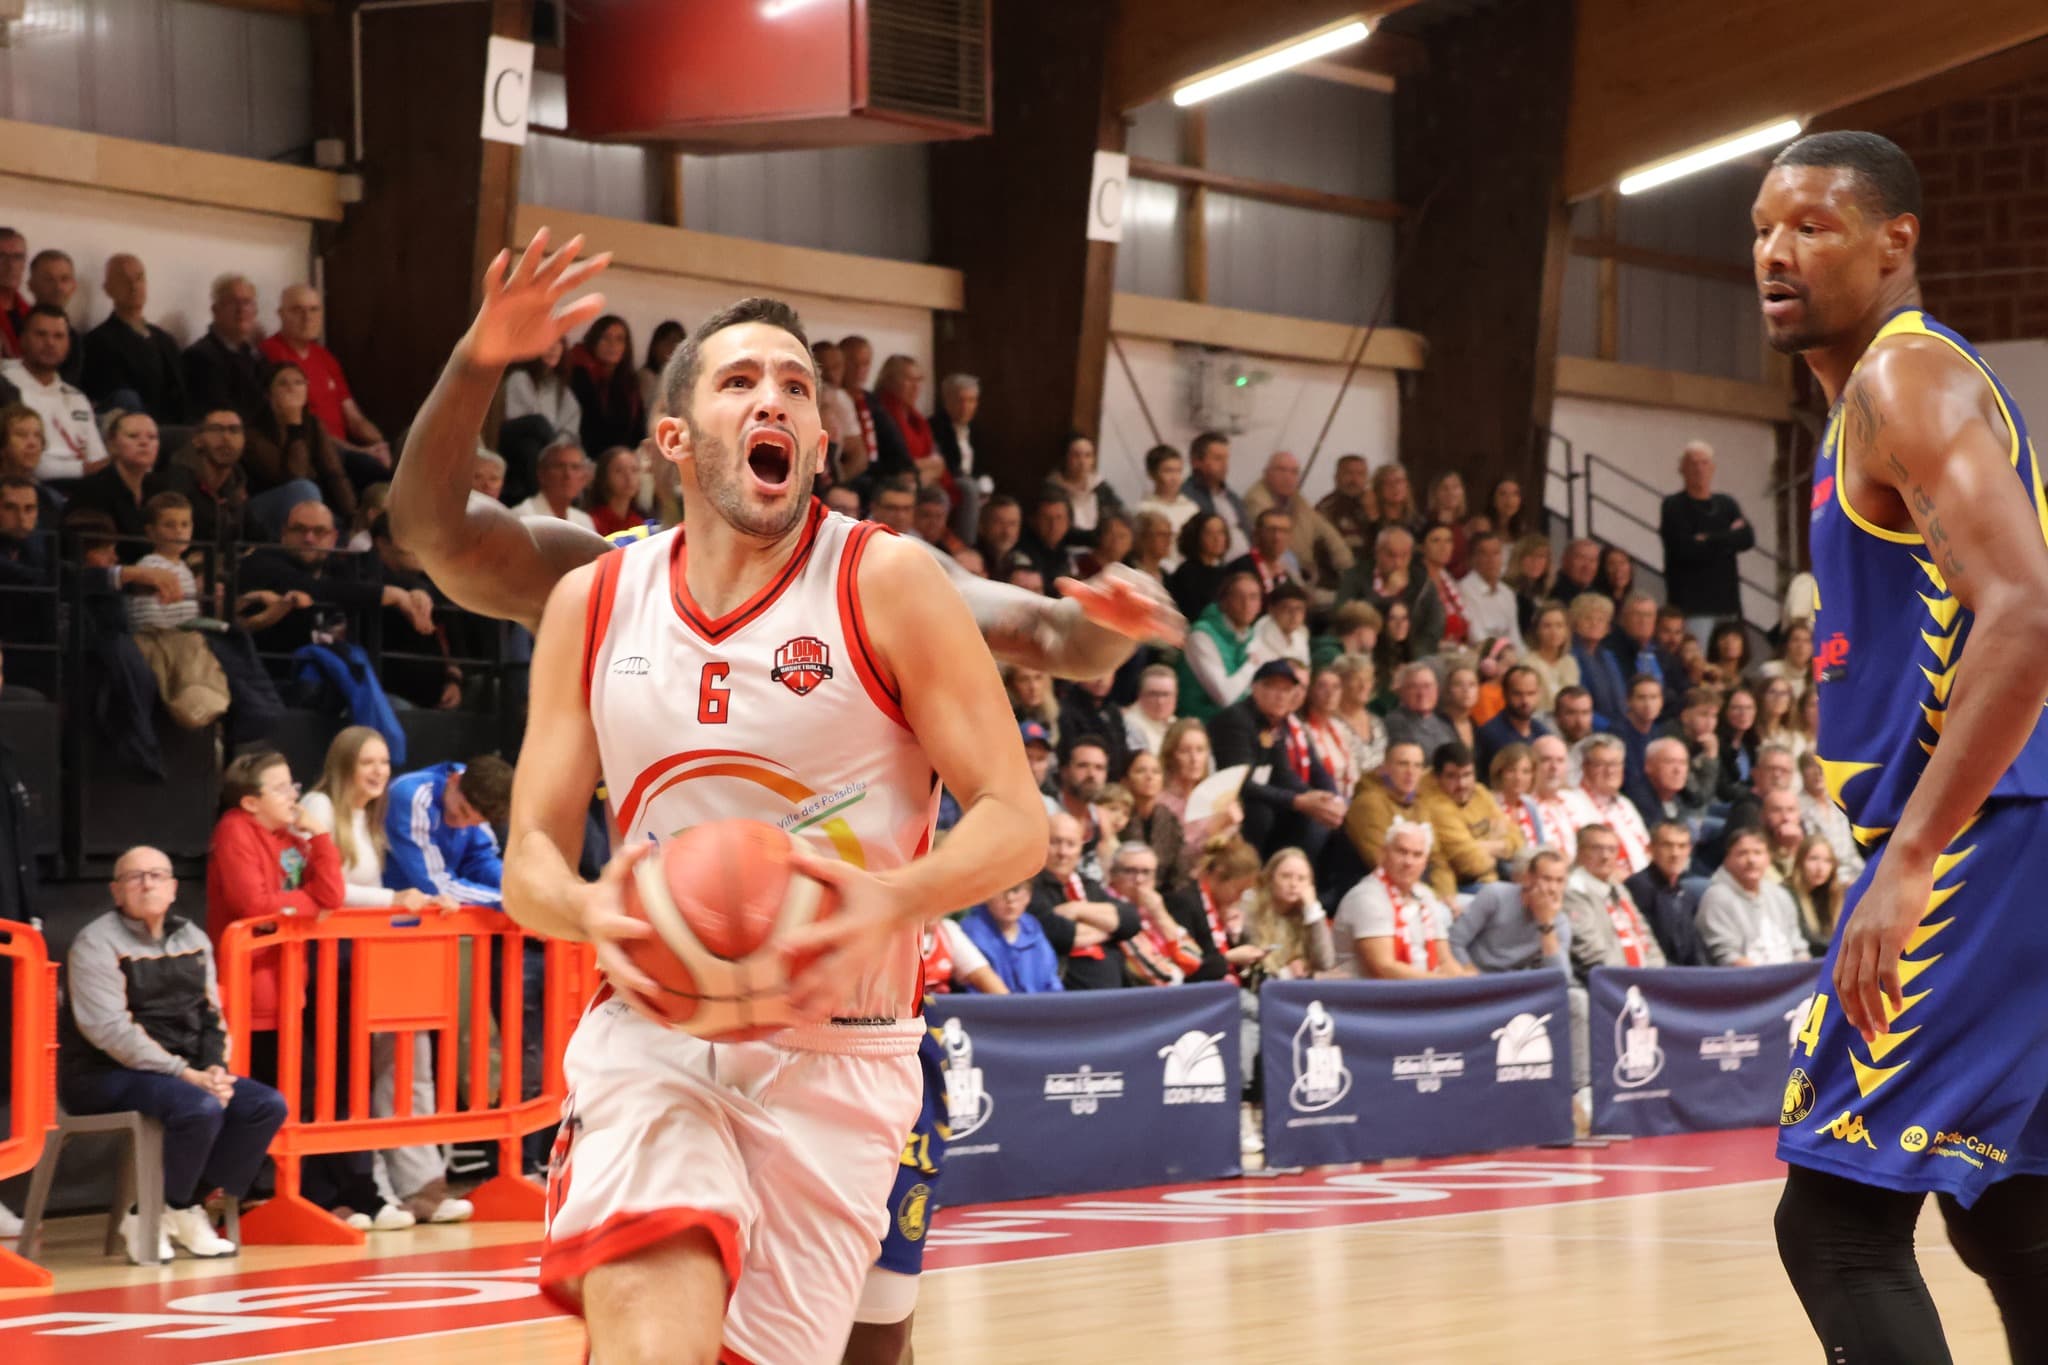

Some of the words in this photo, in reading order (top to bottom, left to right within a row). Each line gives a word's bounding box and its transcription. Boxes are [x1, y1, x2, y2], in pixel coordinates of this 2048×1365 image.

[493, 68, 524, 127] C
[1097, 178, 1121, 228] C
[697, 661, 730, 724] 6
[777, 814, 800, 829] Ville
[801, 802, 820, 817] des
[821, 782, 866, 806] Possibles
[1904, 1131, 1923, 1146] 62
